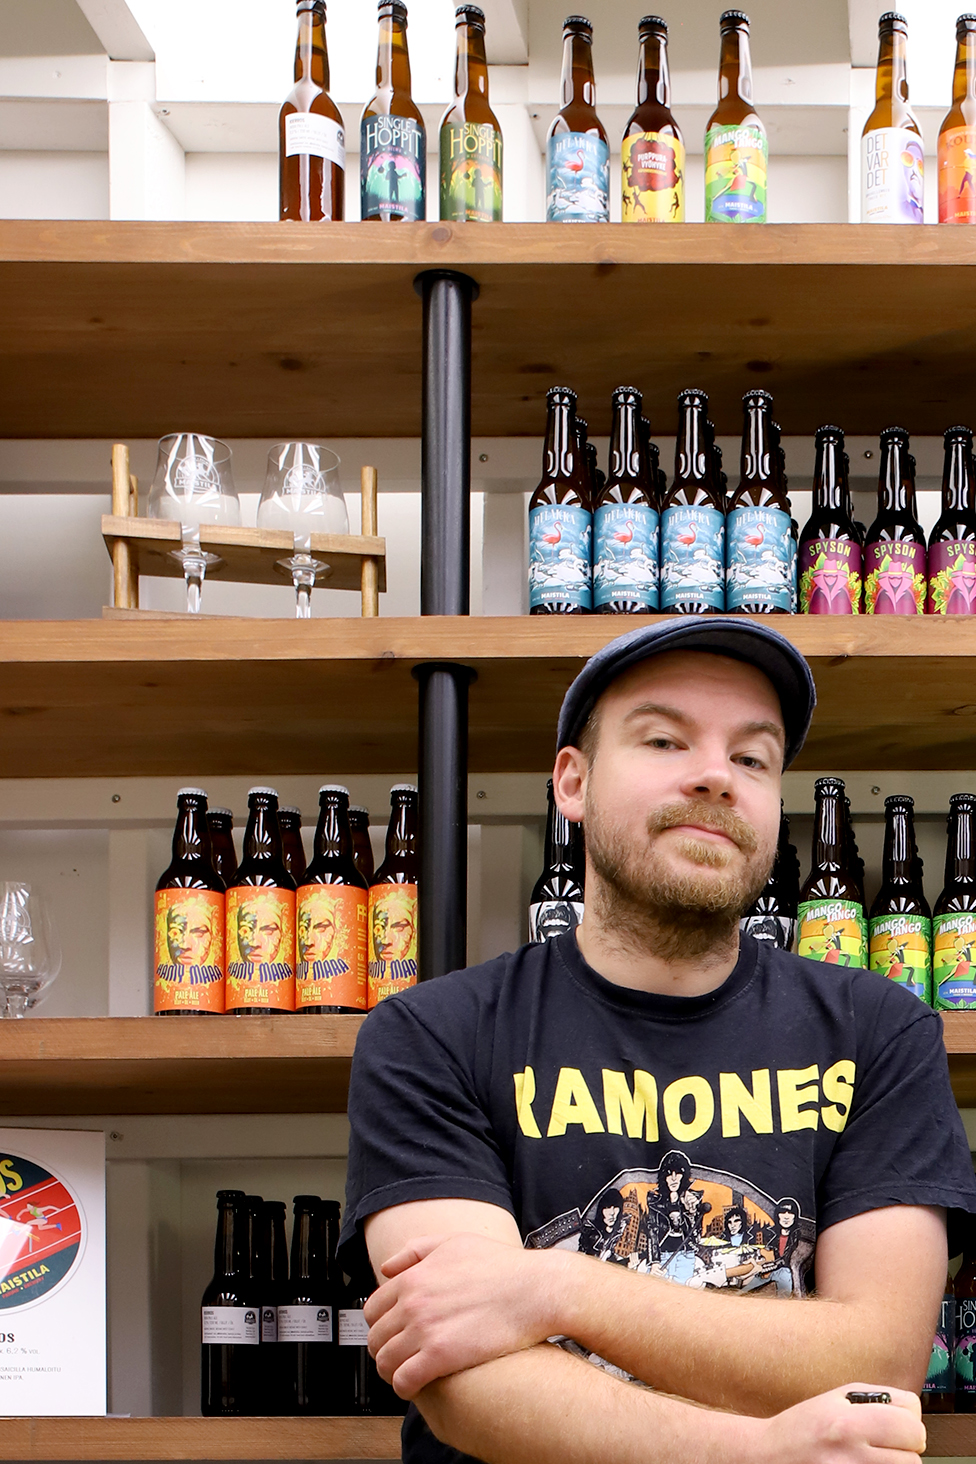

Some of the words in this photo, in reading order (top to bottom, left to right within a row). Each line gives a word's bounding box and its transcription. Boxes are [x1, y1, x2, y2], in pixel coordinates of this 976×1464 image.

[378, 116, 411, 133] SINGLE
[464, 122, 494, 142] SINGLE
[366, 122, 422, 159] HOPPIT
[713, 129, 750, 148] MANGO
[734, 138, 764, 150] TANGO
[867, 133, 888, 154] DET
[450, 128, 502, 169] HOPPIT
[867, 154, 888, 171] VAR
[867, 169, 888, 189] DET
[808, 541, 851, 557] SPYSON
[874, 543, 916, 559] SPYSON
[611, 591, 641, 599] MAISTILA
[675, 592, 704, 600] MAISTILA
[806, 902, 842, 922] MANGO
[826, 908, 857, 923] TANGO
[873, 917, 906, 937] MANGO
[890, 922, 922, 937] TANGO
[939, 915, 973, 935] MANGO
[190, 964, 223, 985] MARA
[259, 962, 293, 983] MARA
[312, 958, 350, 981] MARA
[175, 990, 189, 1000] PALE
[189, 988, 199, 999] ALE
[244, 989, 259, 998] PALE
[259, 987, 268, 997] ALE
[302, 987, 313, 996] PALE
[313, 986, 321, 995] ALE
[378, 987, 390, 996] PALE
[0, 1264, 50, 1294] AISTILA
